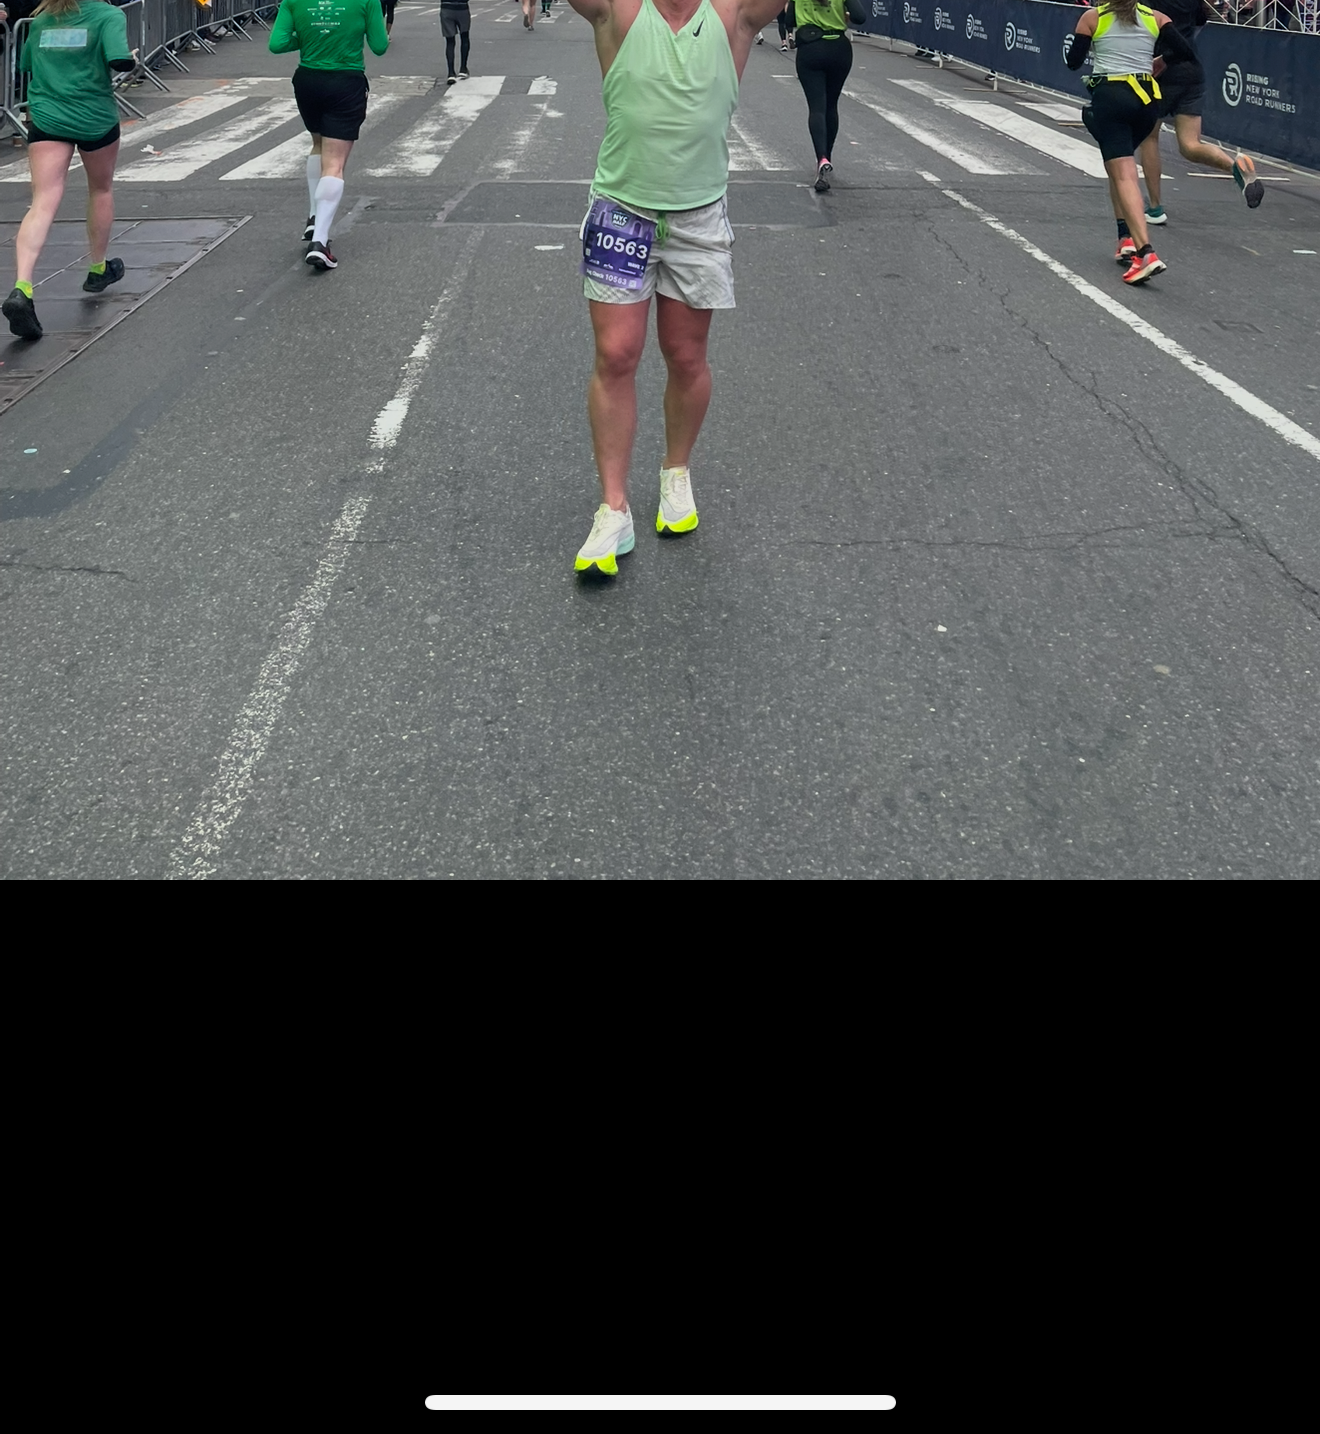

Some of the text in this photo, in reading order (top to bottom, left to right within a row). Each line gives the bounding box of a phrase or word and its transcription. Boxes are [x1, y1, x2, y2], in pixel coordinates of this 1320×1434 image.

[1246, 73, 1269, 85] RISING
[1246, 84, 1280, 99] NEW YORK
[1245, 95, 1296, 114] ROAD RUNNERS
[613, 213, 628, 223] NYC
[596, 231, 648, 259] 10563
[605, 274, 627, 286] 10563
